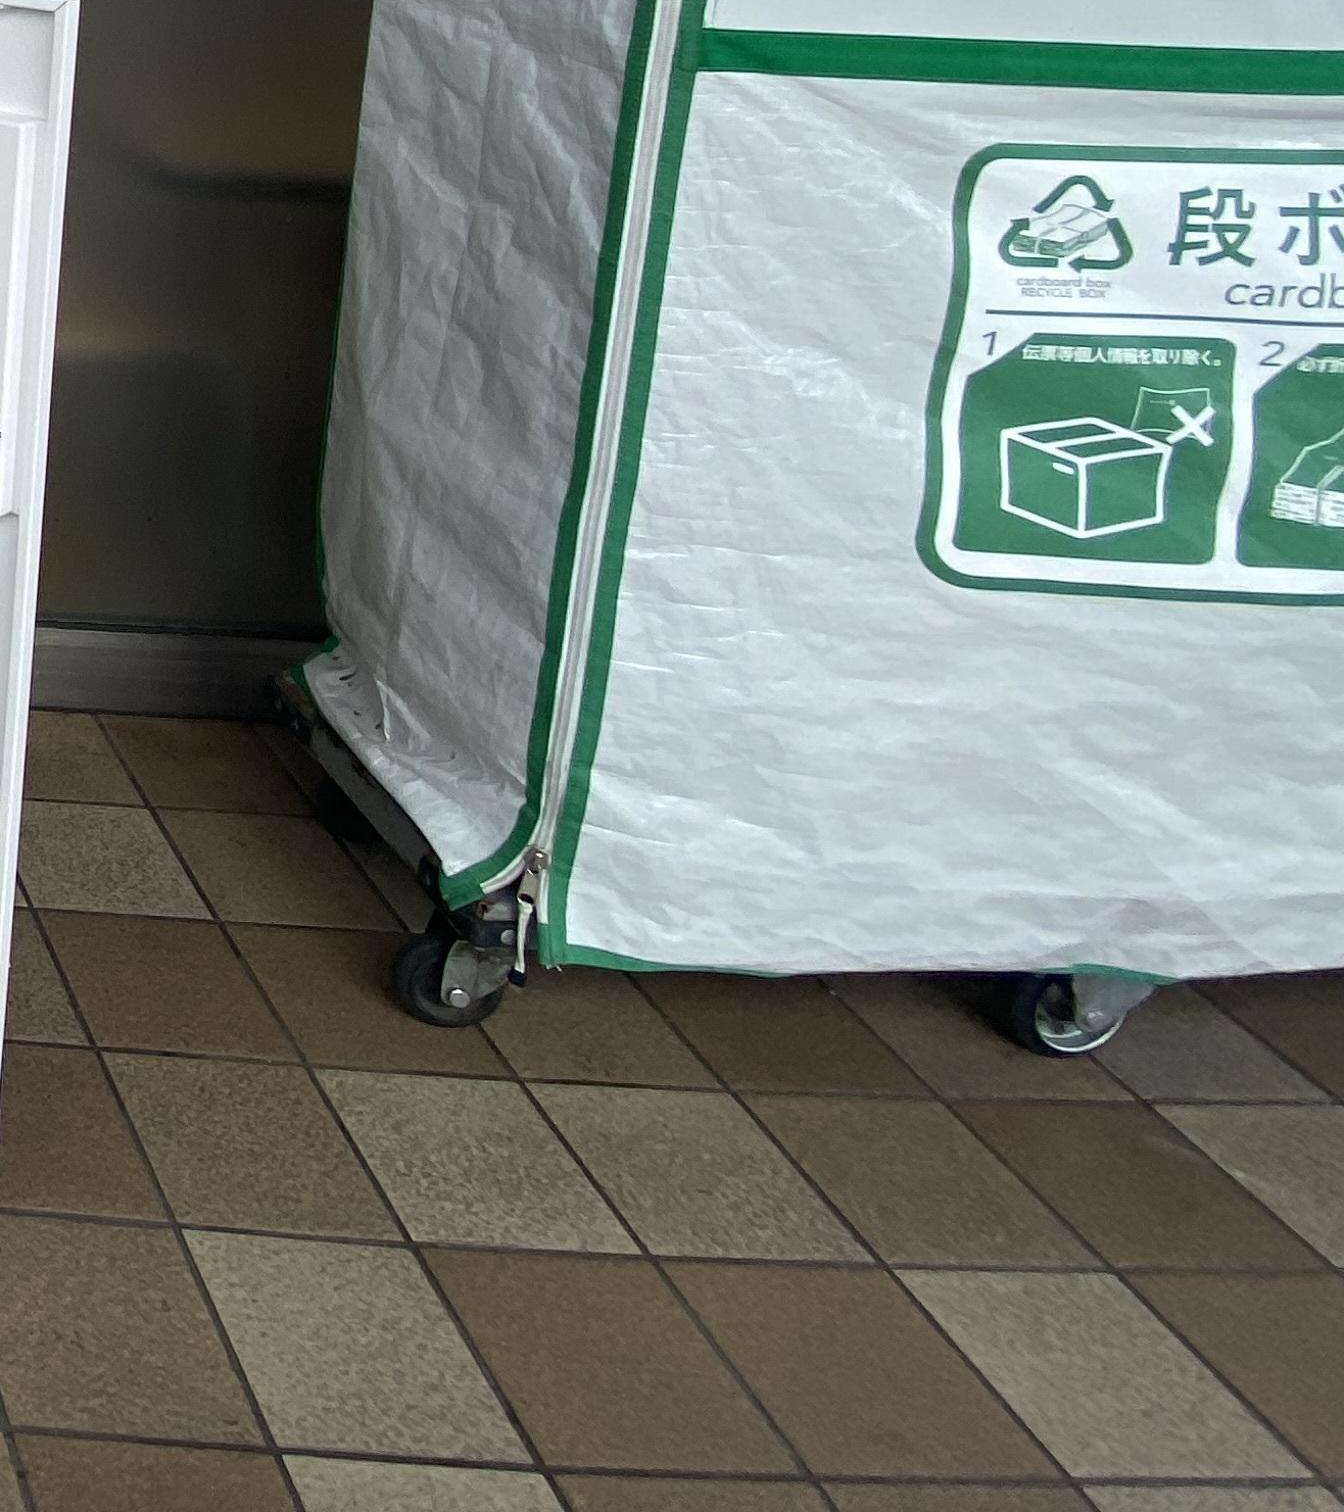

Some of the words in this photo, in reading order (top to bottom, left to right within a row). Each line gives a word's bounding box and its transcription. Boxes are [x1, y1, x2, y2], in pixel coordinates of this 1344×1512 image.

[1016, 276, 1083, 288] cardboard
[1085, 277, 1111, 288] box
[1021, 287, 1074, 299] RECYCLE
[1079, 288, 1106, 299] BOX
[982, 331, 998, 357] 1
[1258, 340, 1286, 367] 2
